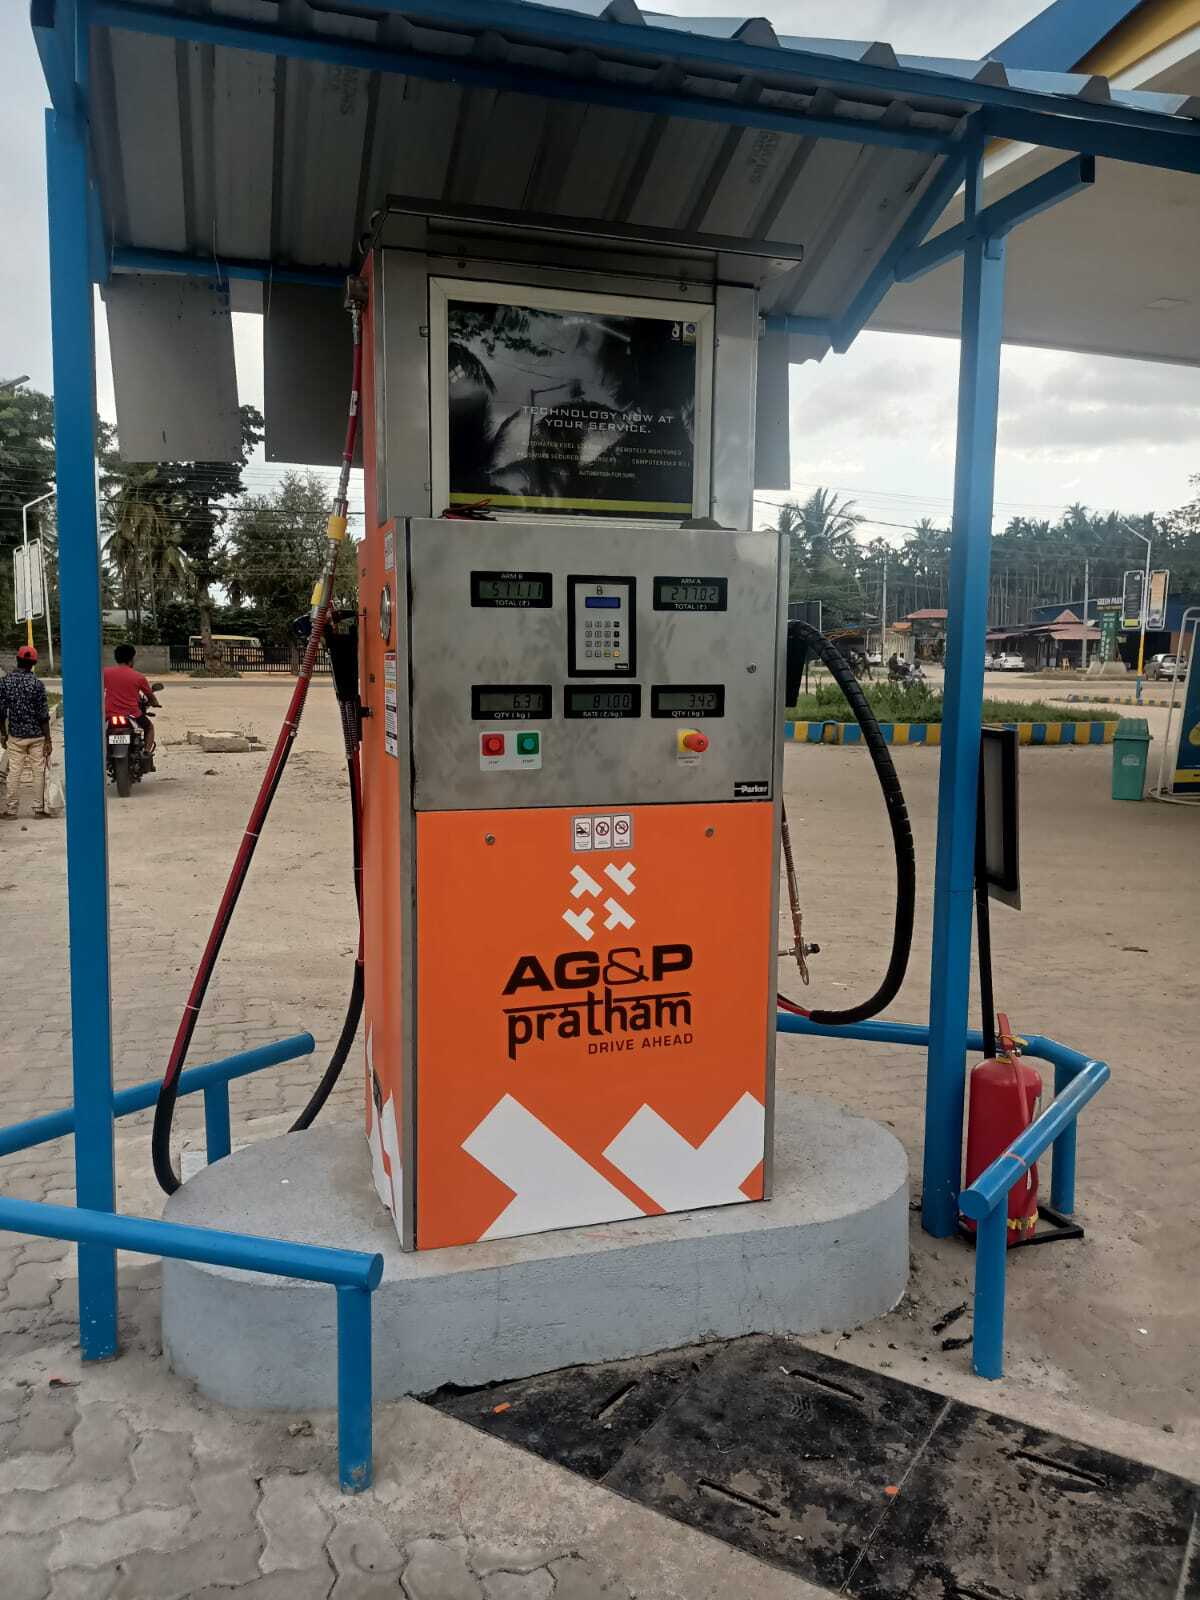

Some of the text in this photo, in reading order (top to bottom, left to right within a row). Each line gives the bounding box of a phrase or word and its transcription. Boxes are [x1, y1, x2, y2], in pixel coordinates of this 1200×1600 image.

[522, 405, 673, 424] TECHNOLOGY NOW AT
[544, 419, 651, 434] YOUR SERVICE.
[493, 711, 510, 720] QTY
[740, 784, 768, 793] Parker
[501, 943, 694, 996] AG&P
[502, 986, 692, 1062] pratham
[588, 1032, 693, 1054] DRIVE AHEAD
